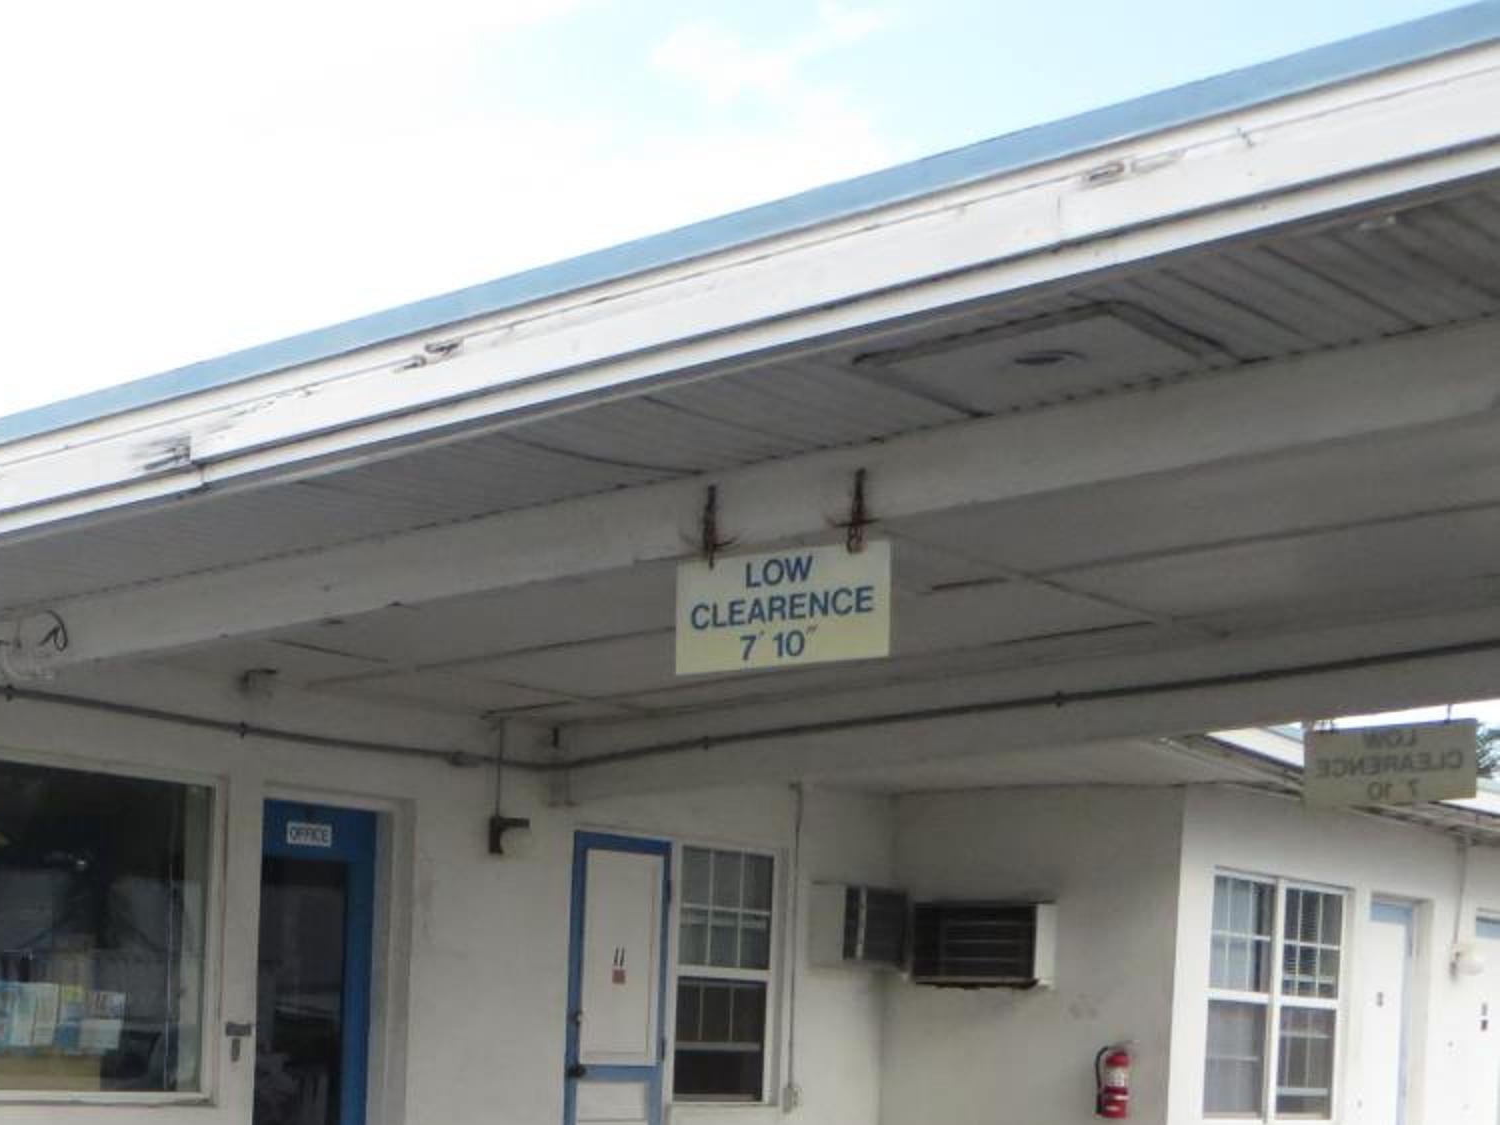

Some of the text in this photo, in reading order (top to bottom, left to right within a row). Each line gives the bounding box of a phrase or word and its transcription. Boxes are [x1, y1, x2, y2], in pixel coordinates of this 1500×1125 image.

[745, 556, 813, 588] LOW
[690, 585, 875, 630] CLEARENCE
[289, 827, 329, 843] OFFICE
